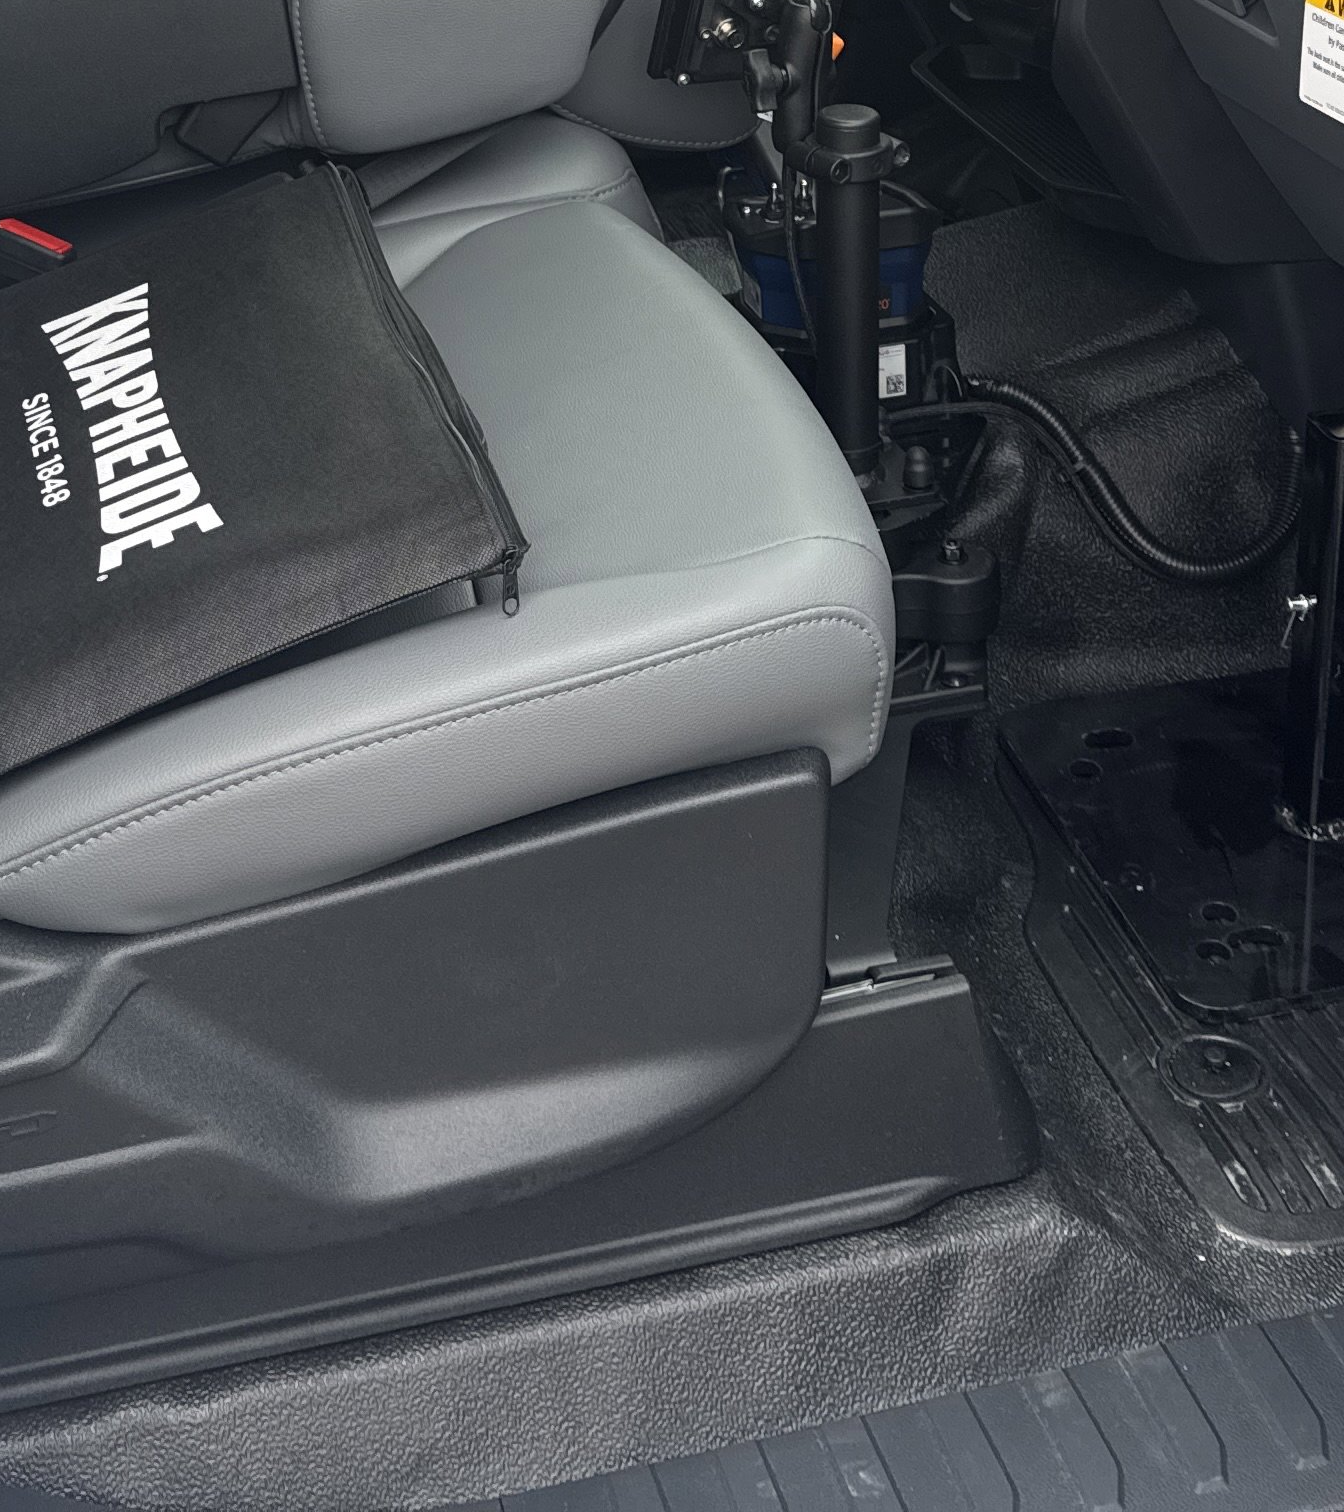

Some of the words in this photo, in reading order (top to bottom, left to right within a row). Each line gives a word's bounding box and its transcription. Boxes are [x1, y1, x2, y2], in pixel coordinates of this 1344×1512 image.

[22, 392, 59, 458] SINCE
[41, 283, 224, 573] KNAPHEIDE
[36, 454, 71, 507] 1848
